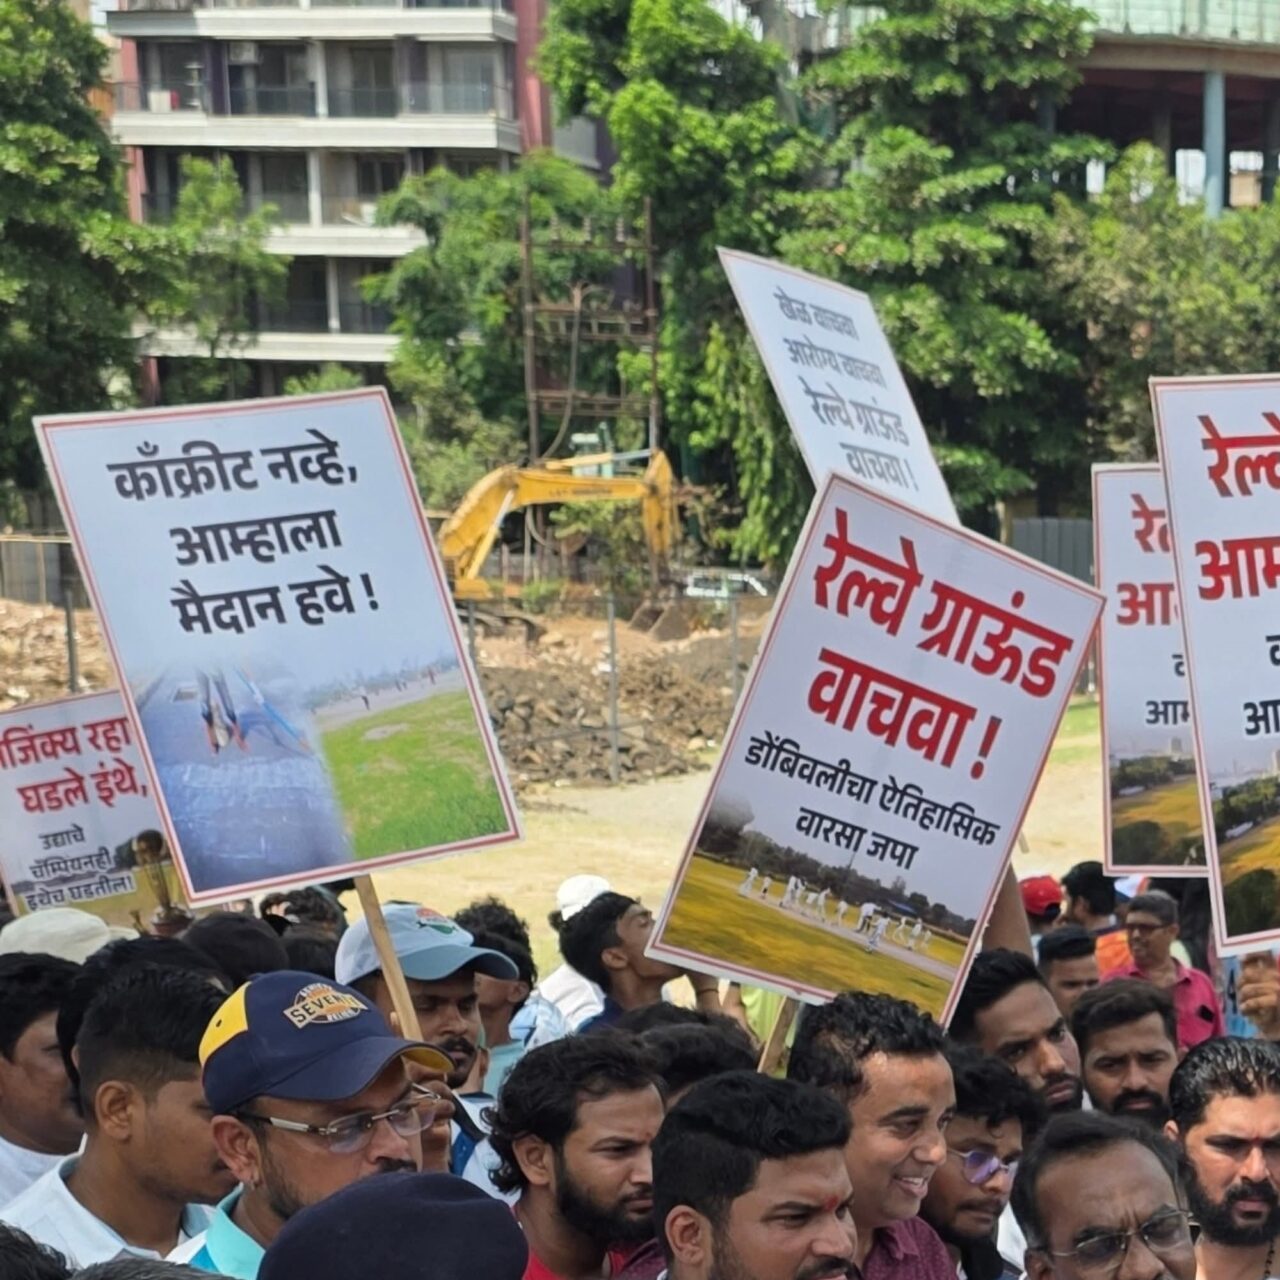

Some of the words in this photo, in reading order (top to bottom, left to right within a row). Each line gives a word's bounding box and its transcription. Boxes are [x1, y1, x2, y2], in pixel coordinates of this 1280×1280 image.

[798, 375, 855, 430] रेल्वे
[261, 429, 358, 486] नव्हे,
[170, 509, 343, 566] आम्हाला
[171, 579, 286, 634] मैदान
[813, 507, 924, 637] रेल्वे
[916, 579, 1074, 698] ग्राऊंड
[0, 723, 82, 769] जिंक्य
[82, 717, 131, 753] रहा
[16, 766, 89, 813] घडले
[744, 731, 878, 804] डोंबिवलीचा
[878, 776, 1001, 849] ऐतिहासिक
[38, 823, 86, 850] उद्याचे
[795, 807, 868, 855] वारसा
[866, 832, 920, 871] जपा
